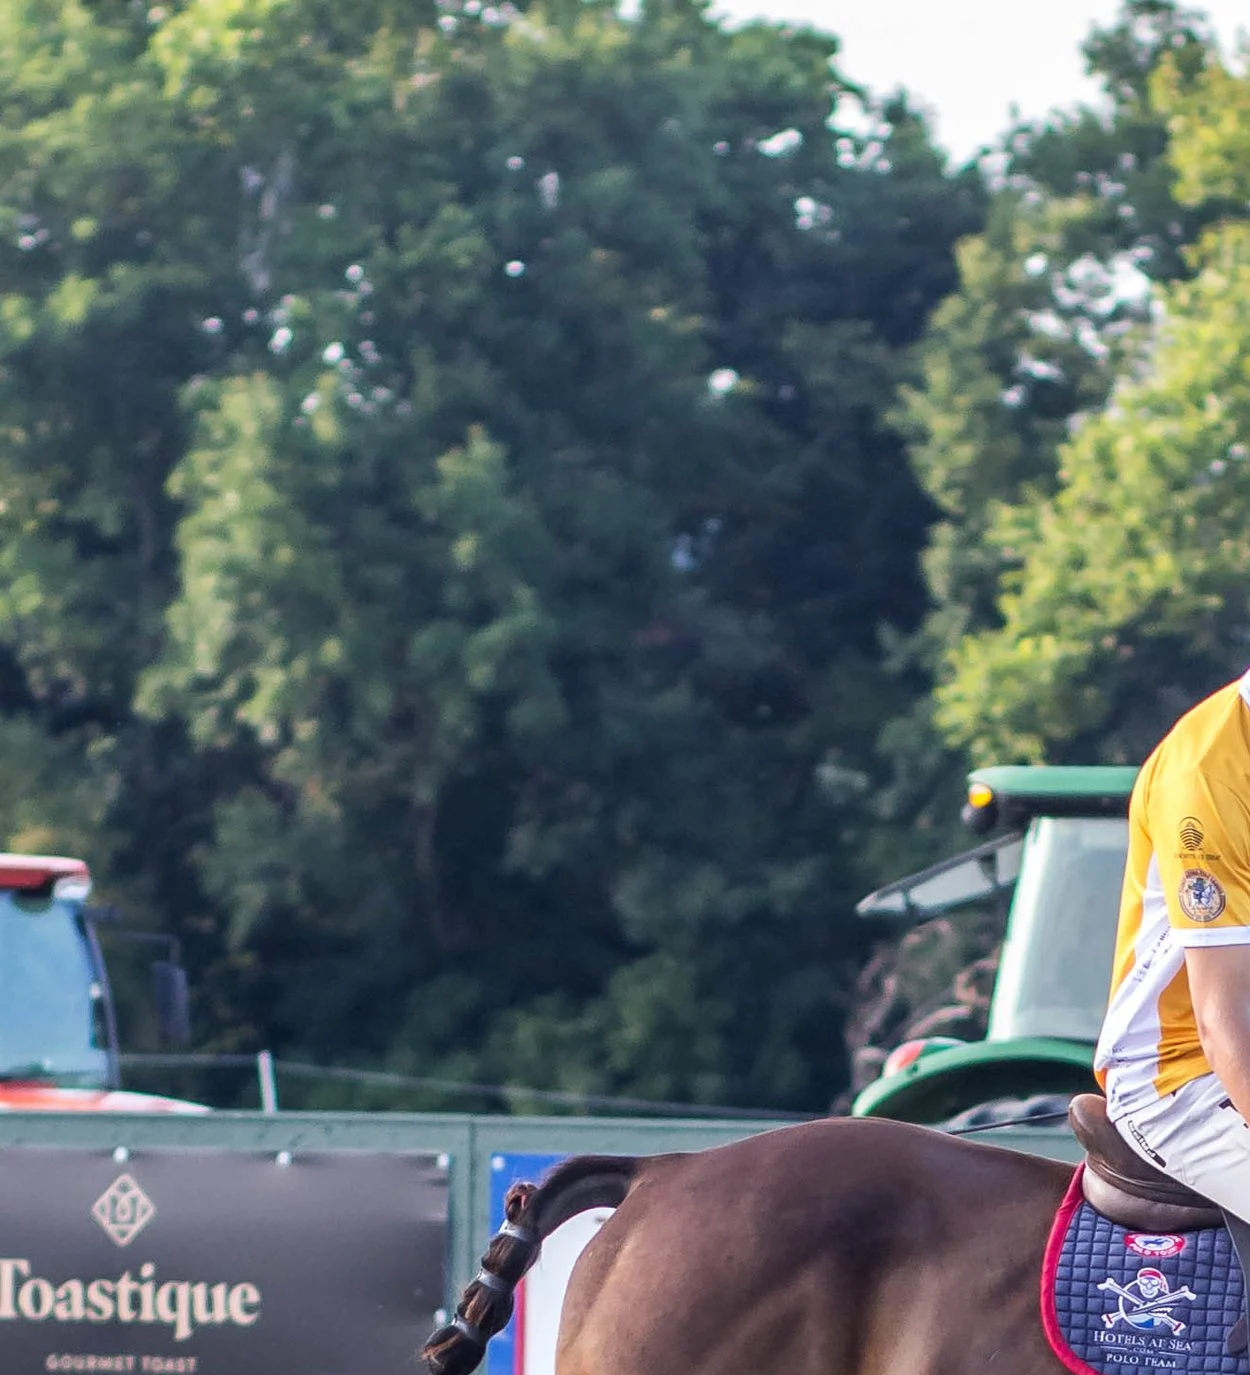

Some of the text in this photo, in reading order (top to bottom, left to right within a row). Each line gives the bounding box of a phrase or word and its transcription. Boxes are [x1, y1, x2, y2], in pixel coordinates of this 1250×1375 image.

[0, 1258, 261, 1341] Toastique
[1093, 1330, 1145, 1346] HOTELS
[46, 1354, 198, 1373] GOURMET TOAST
[1106, 1353, 1176, 1368] POLO TEAM
